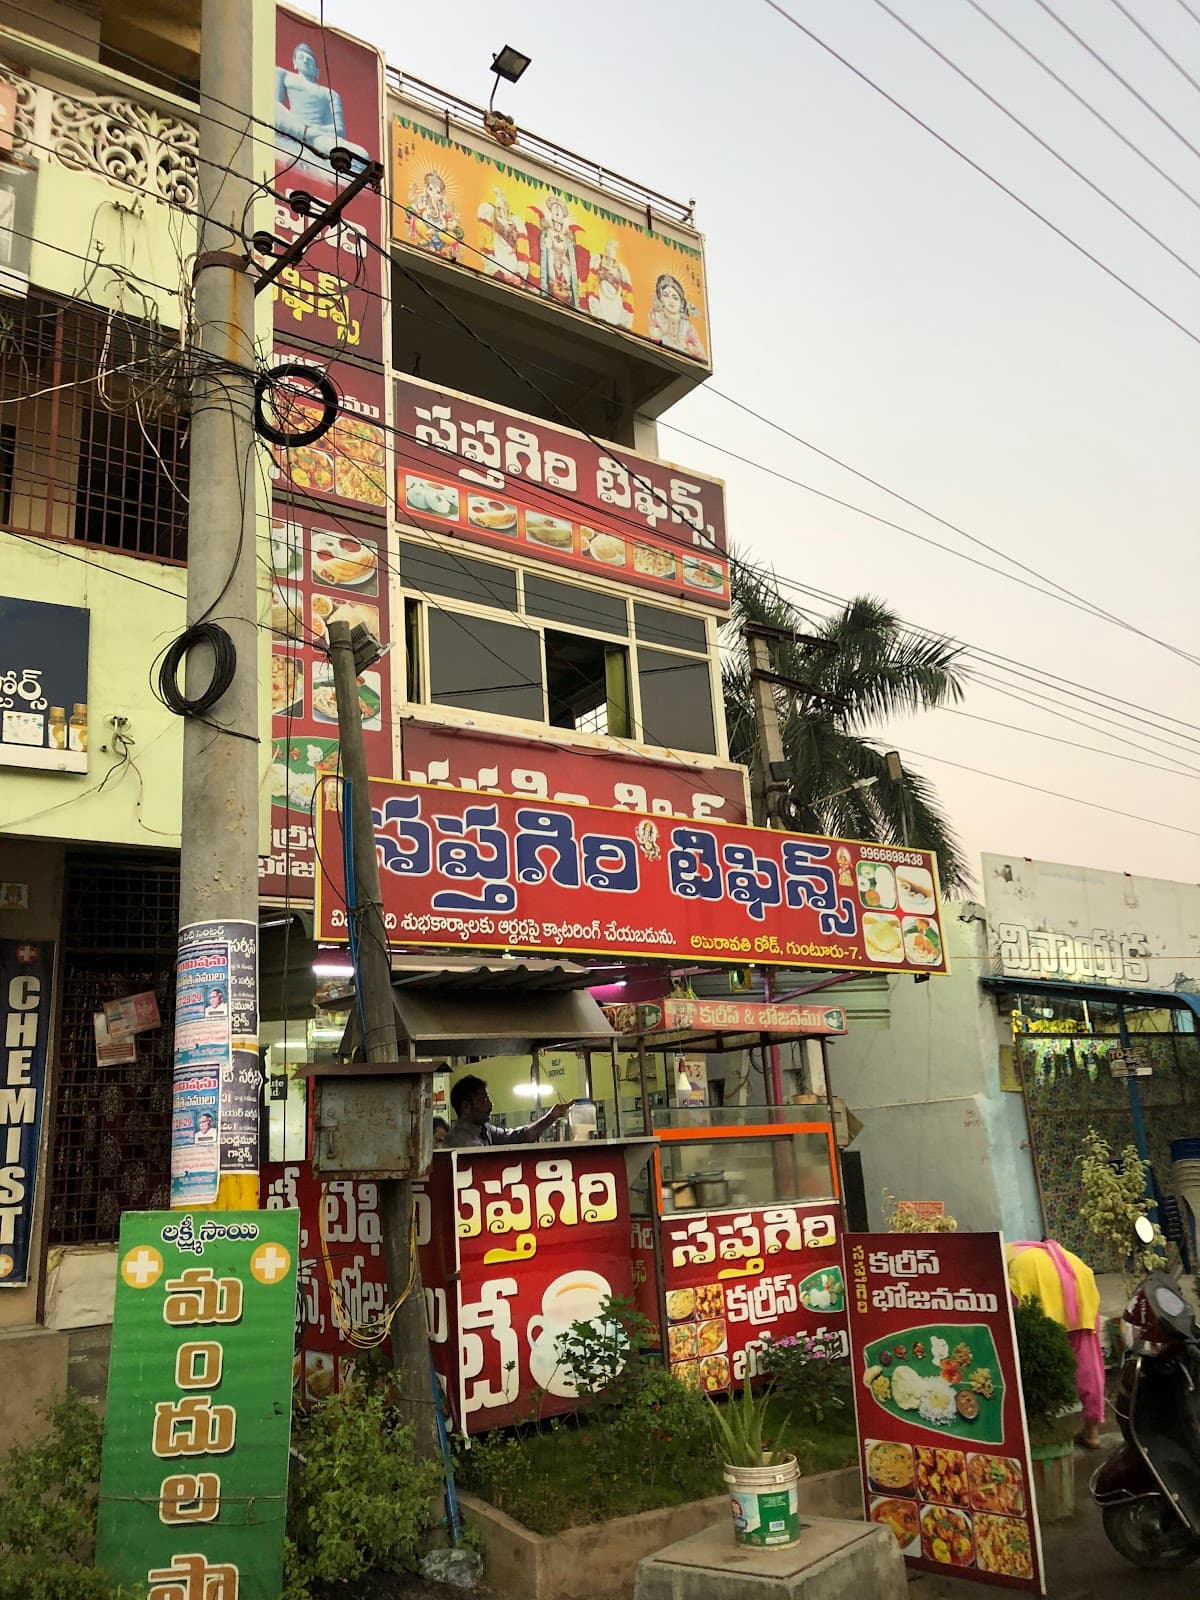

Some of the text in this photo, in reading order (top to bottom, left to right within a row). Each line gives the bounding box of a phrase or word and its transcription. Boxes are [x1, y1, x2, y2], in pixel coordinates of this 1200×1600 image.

[273, 266, 360, 346] ఫిన్స్
[414, 405, 578, 492] సప్తగిరి
[370, 794, 857, 936] సప్తగిరి టిఫిన్స్
[860, 847, 924, 866] 9966898438
[401, 913, 495, 940] శుభకార్యాలకు
[542, 920, 602, 945] క్యాటరింగ్
[604, 920, 677, 945] చేయబడును.
[754, 935, 784, 956] రోడ్,
[786, 941, 863, 960] గుంటూరు-7.
[759, 1006, 822, 1028] భోజనము
[0, 976, 41, 1245] CHEMIST
[669, 1208, 837, 1280] సప్తగిరి
[867, 1249, 941, 1277] కర్రీస్
[726, 1273, 798, 1326] కర్రీస్
[871, 1282, 999, 1313] భోజనము
